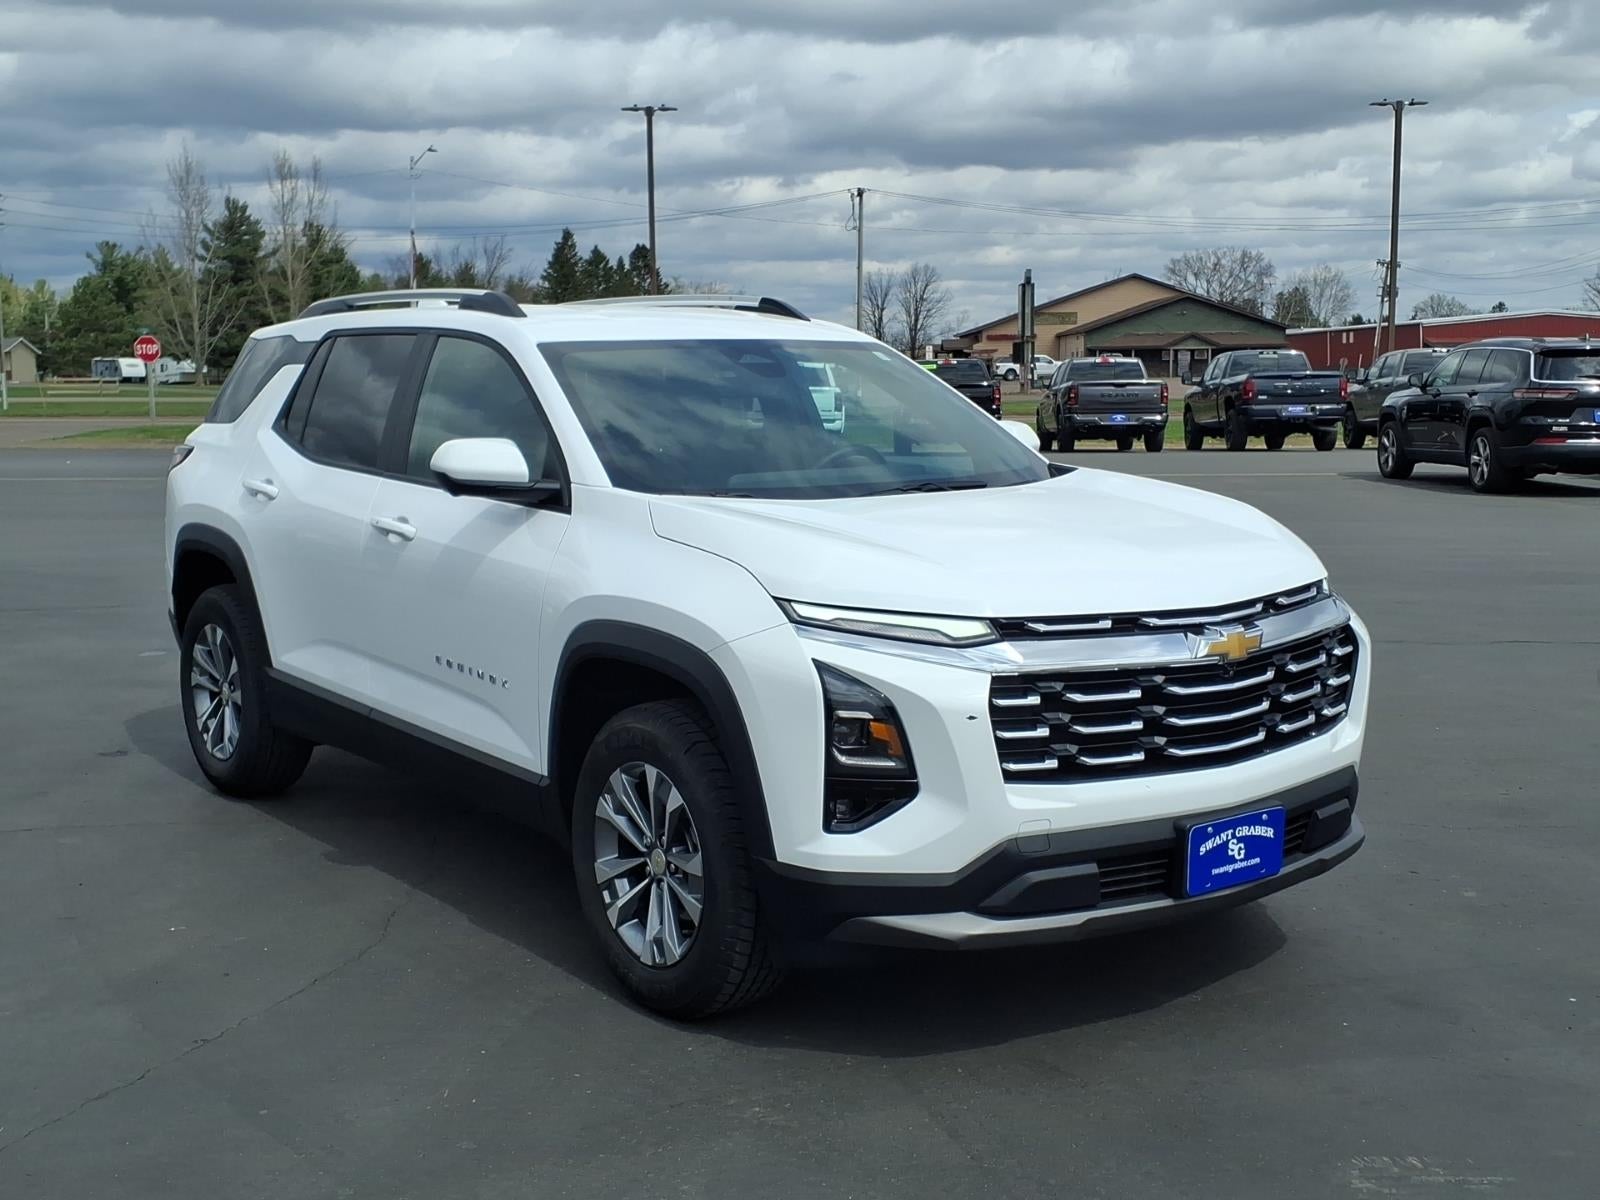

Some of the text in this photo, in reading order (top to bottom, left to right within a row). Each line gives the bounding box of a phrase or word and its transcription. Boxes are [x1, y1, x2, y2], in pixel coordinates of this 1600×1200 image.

[136, 344, 158, 355] STOP
[435, 655, 509, 689] EQUINOX
[1199, 825, 1275, 856] SWANT GRABER
[1227, 838, 1246, 860] SG
[1211, 857, 1261, 875] swantgraber.com
